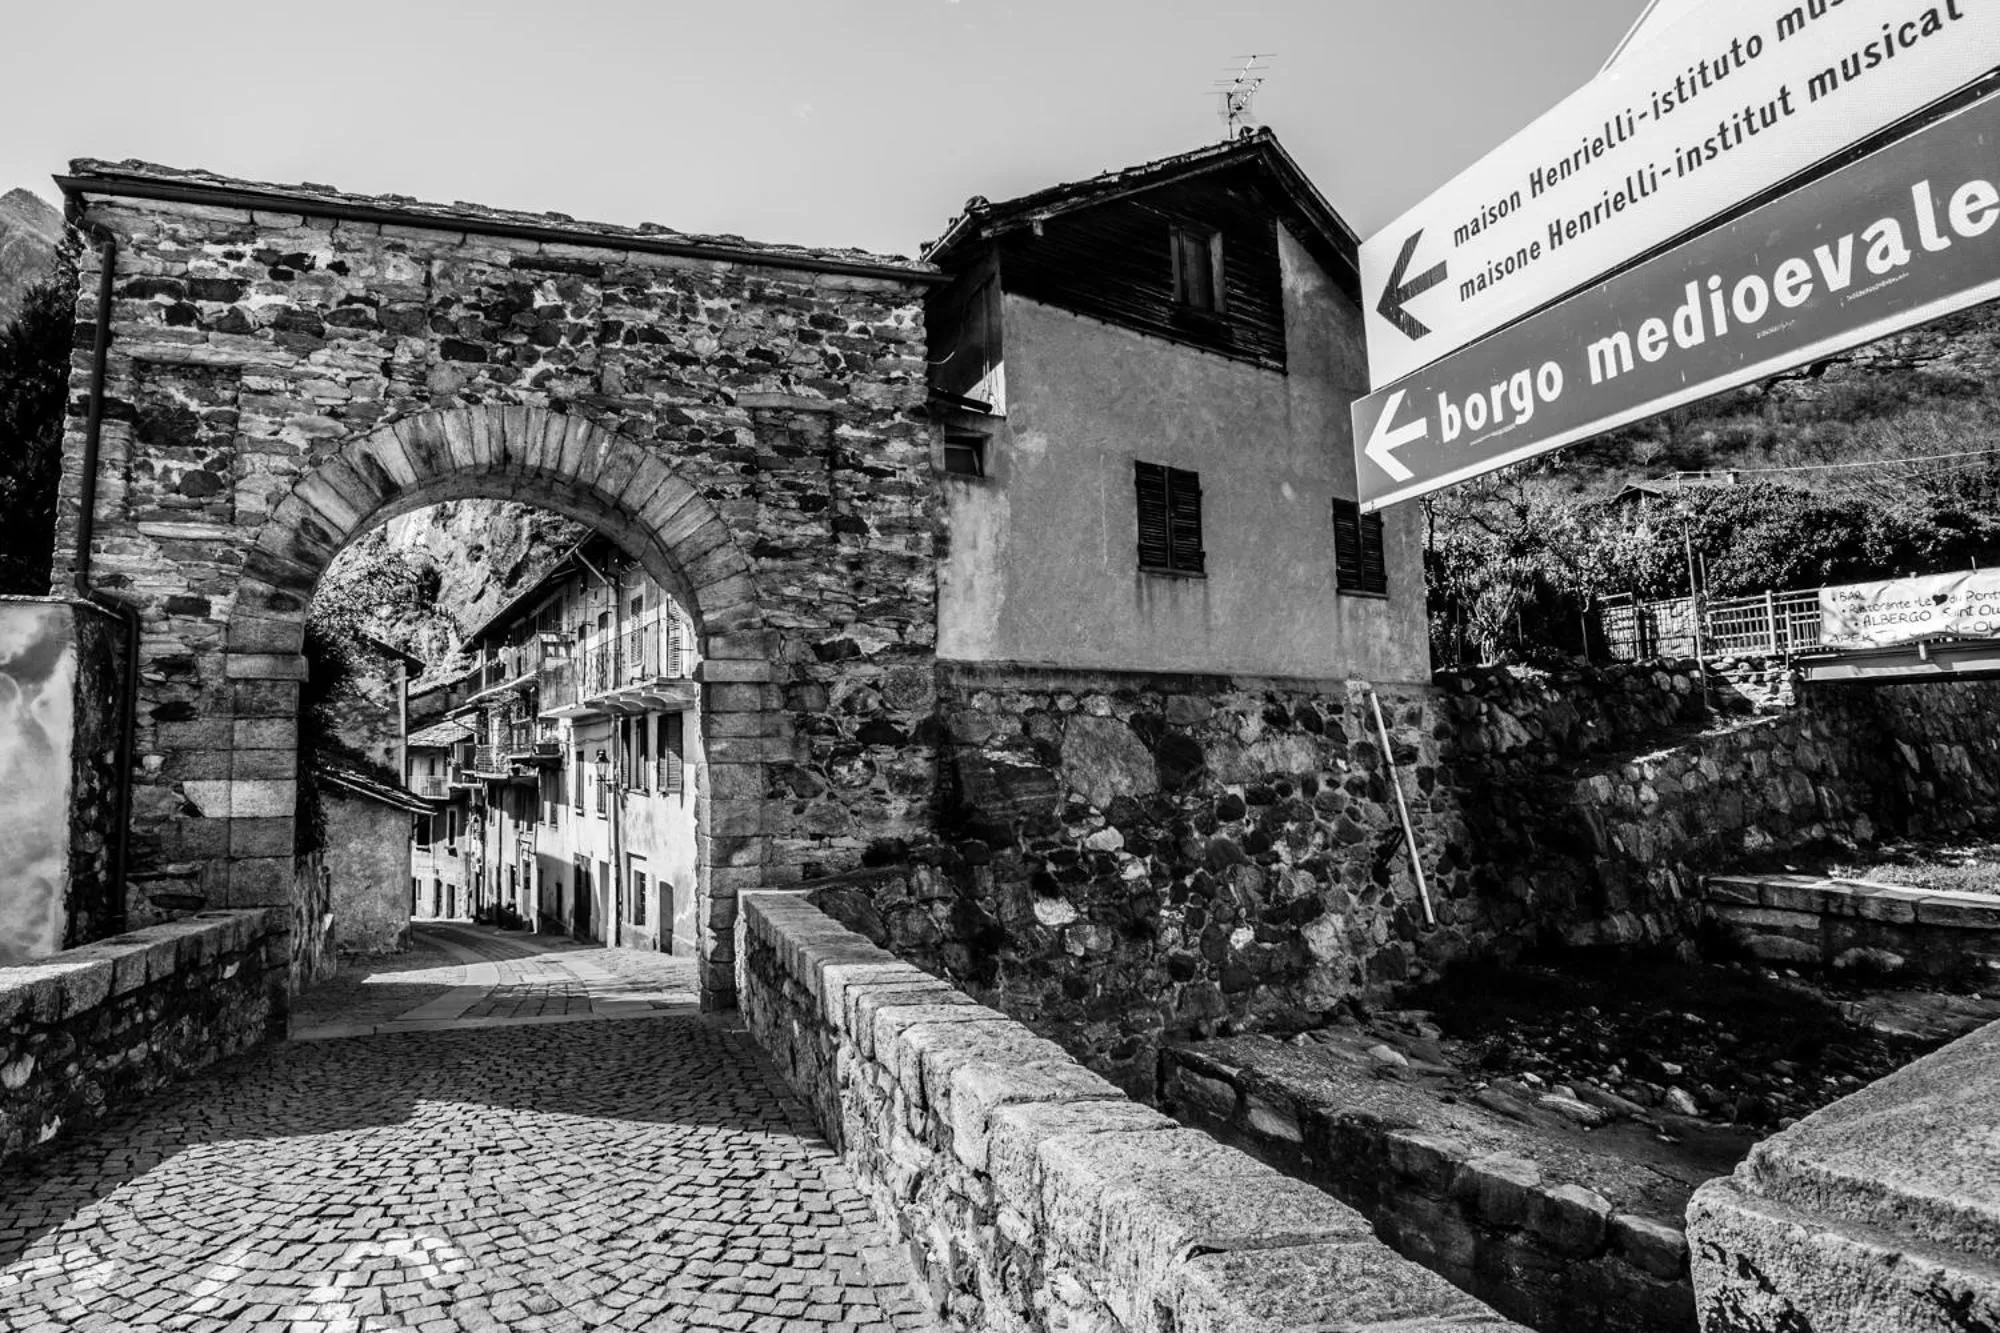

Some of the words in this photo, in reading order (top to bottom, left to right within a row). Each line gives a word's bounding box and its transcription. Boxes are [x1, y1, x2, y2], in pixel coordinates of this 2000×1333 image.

[1454, 190, 1521, 247] maison
[1529, 35, 1763, 199] Henrielli-istituto
[1776, 0, 1844, 42] mu
[1459, 240, 1541, 302] maisone
[1547, 84, 1796, 251] Henrielli-institut
[1438, 361, 1563, 443] borgo
[1587, 178, 2000, 385] medioevale
[1863, 611, 1932, 628] ALBERGO
